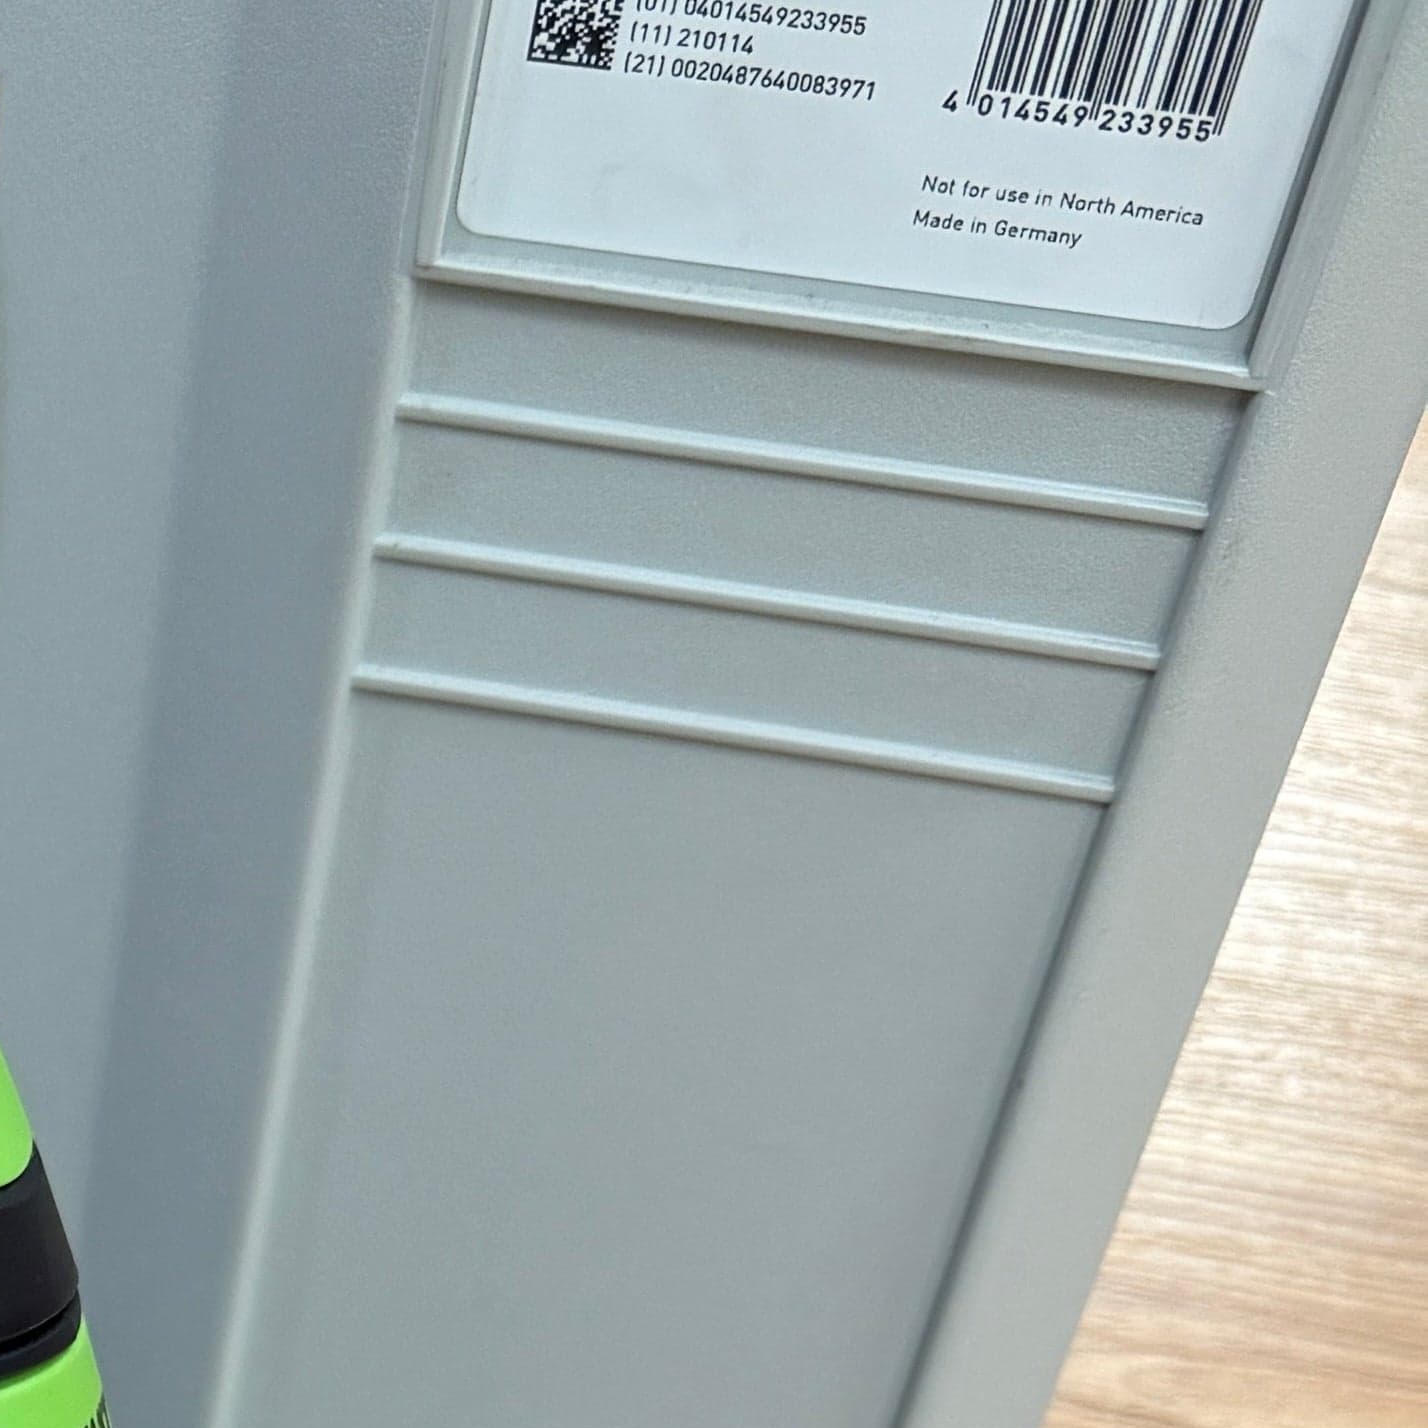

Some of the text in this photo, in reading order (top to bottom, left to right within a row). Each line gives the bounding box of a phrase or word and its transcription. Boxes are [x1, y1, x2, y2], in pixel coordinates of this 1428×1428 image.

[631, 20, 754, 55] (11) 210114
[685, 0, 868, 36] 04014549233955
[624, 52, 876, 101] (21) 0020487640083971
[922, 174, 1204, 227] Not for use in North America
[913, 207, 1083, 250] Made in Germany
